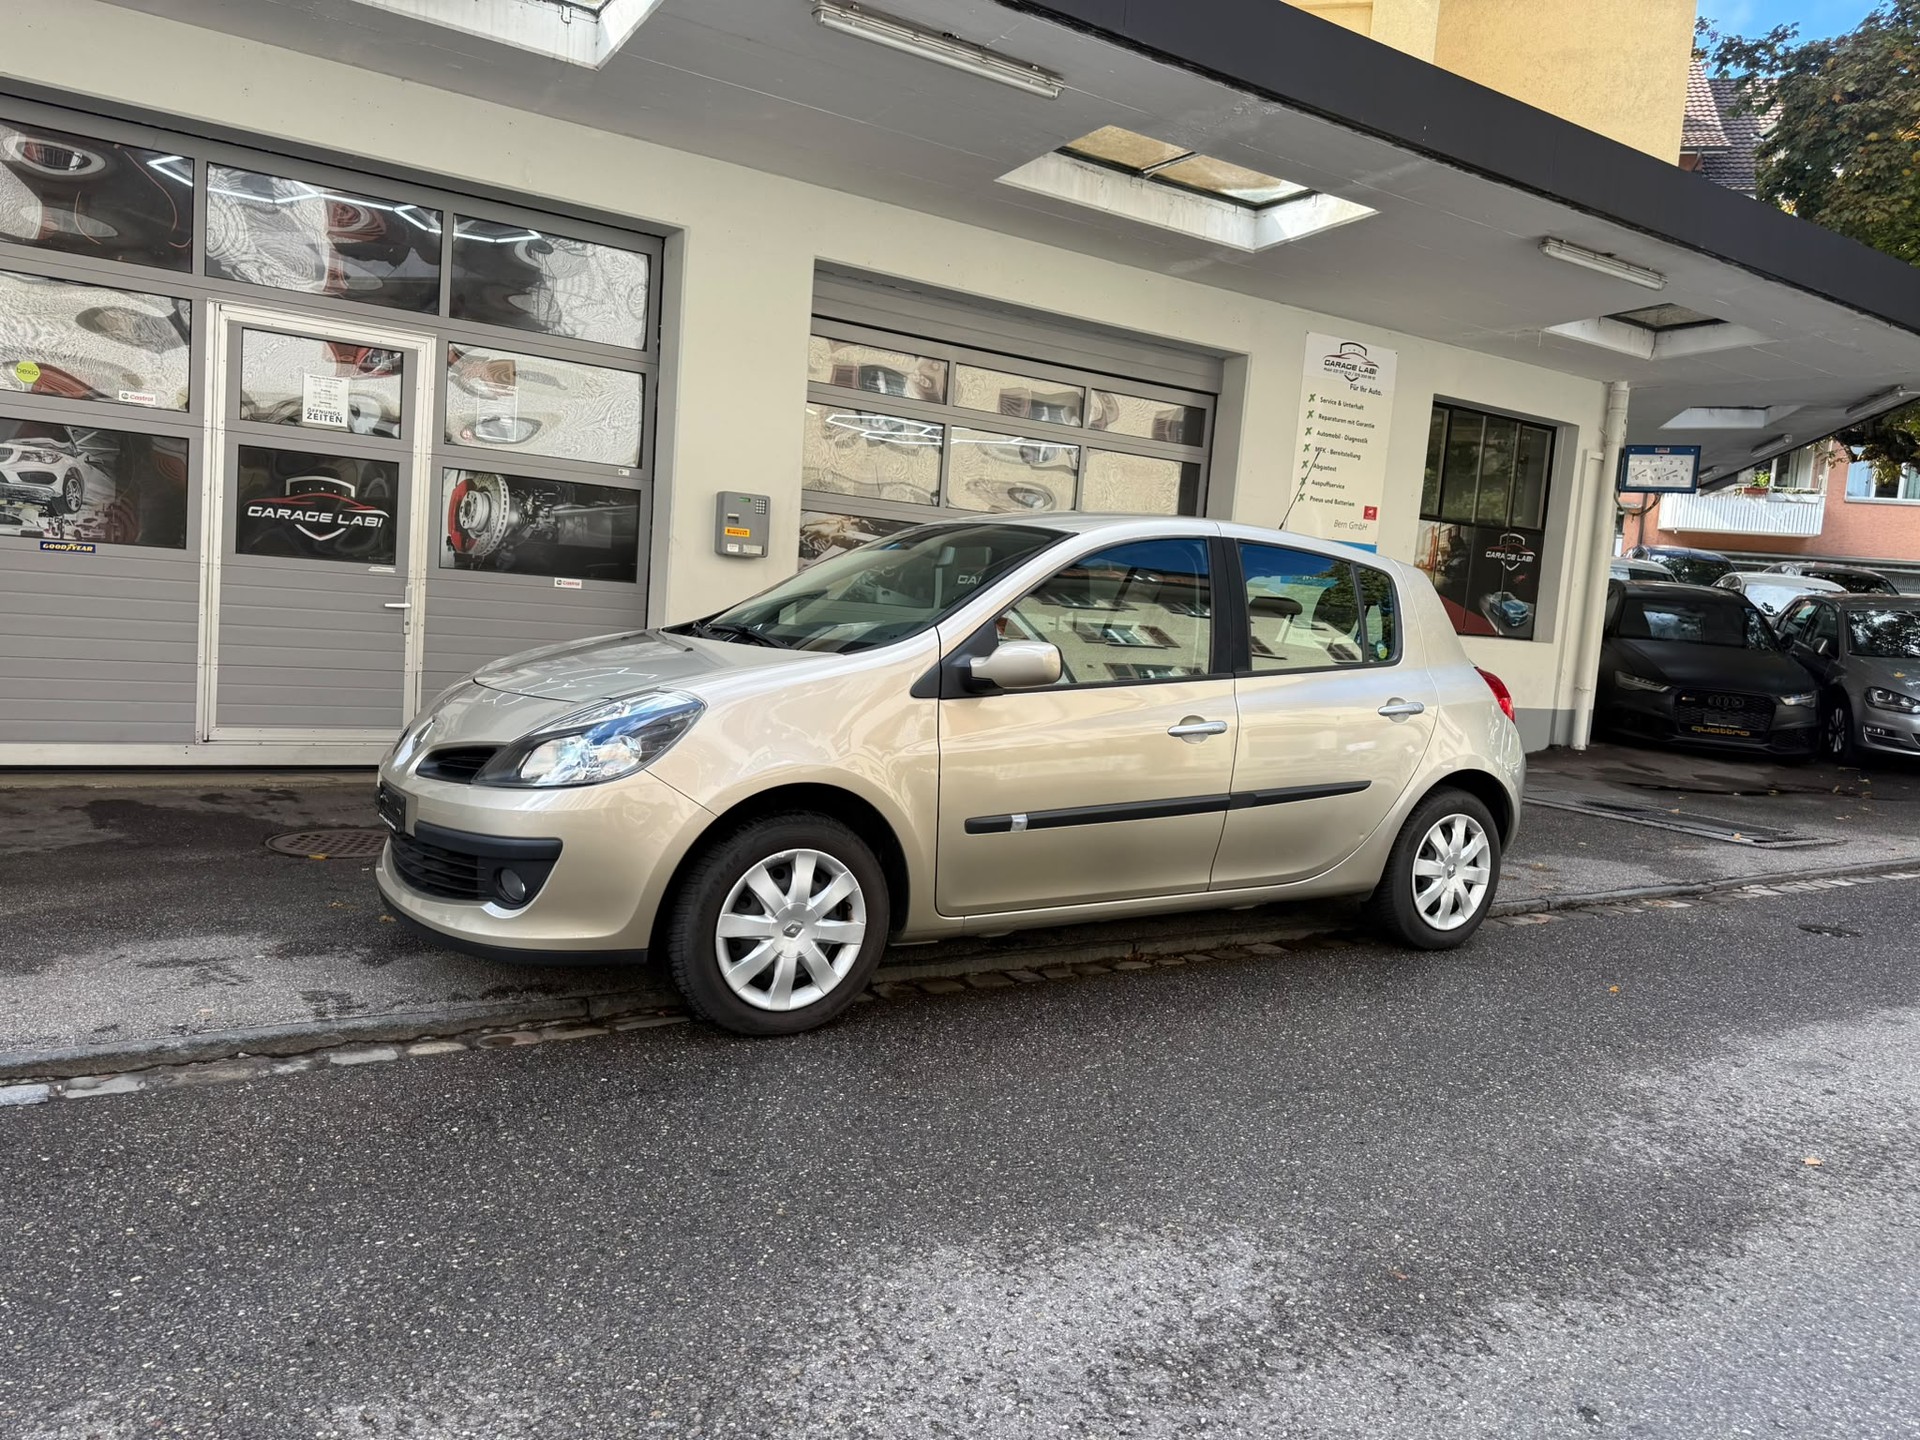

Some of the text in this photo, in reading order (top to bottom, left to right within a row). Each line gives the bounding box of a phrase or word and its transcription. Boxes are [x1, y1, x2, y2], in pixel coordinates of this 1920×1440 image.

[16, 367, 39, 376] bexio
[1324, 359, 1358, 371] GARAGE
[1358, 365, 1377, 375] LABI
[1349, 383, 1359, 391] Für
[129, 394, 154, 402] Castrol
[1320, 396, 1337, 406] Service
[1342, 401, 1364, 411] Unterhalt
[306, 412, 343, 424] ZEITEN
[1318, 413, 1375, 429] Reparaturen mit Garantie
[1316, 430, 1341, 440] Automobil
[1344, 434, 1368, 444] Diagnostik
[1330, 448, 1361, 461] Bereitstellung
[1311, 479, 1345, 490] Auspuffservice
[1309, 495, 1324, 503] Pneus
[1334, 498, 1355, 507] Batterien
[247, 505, 384, 528] GARAGE LABI
[1333, 519, 1369, 531] Bern GmbH
[42, 543, 93, 552] GOODYEAR
[1516, 555, 1534, 563] LABI
[1690, 725, 1751, 737] quattro
